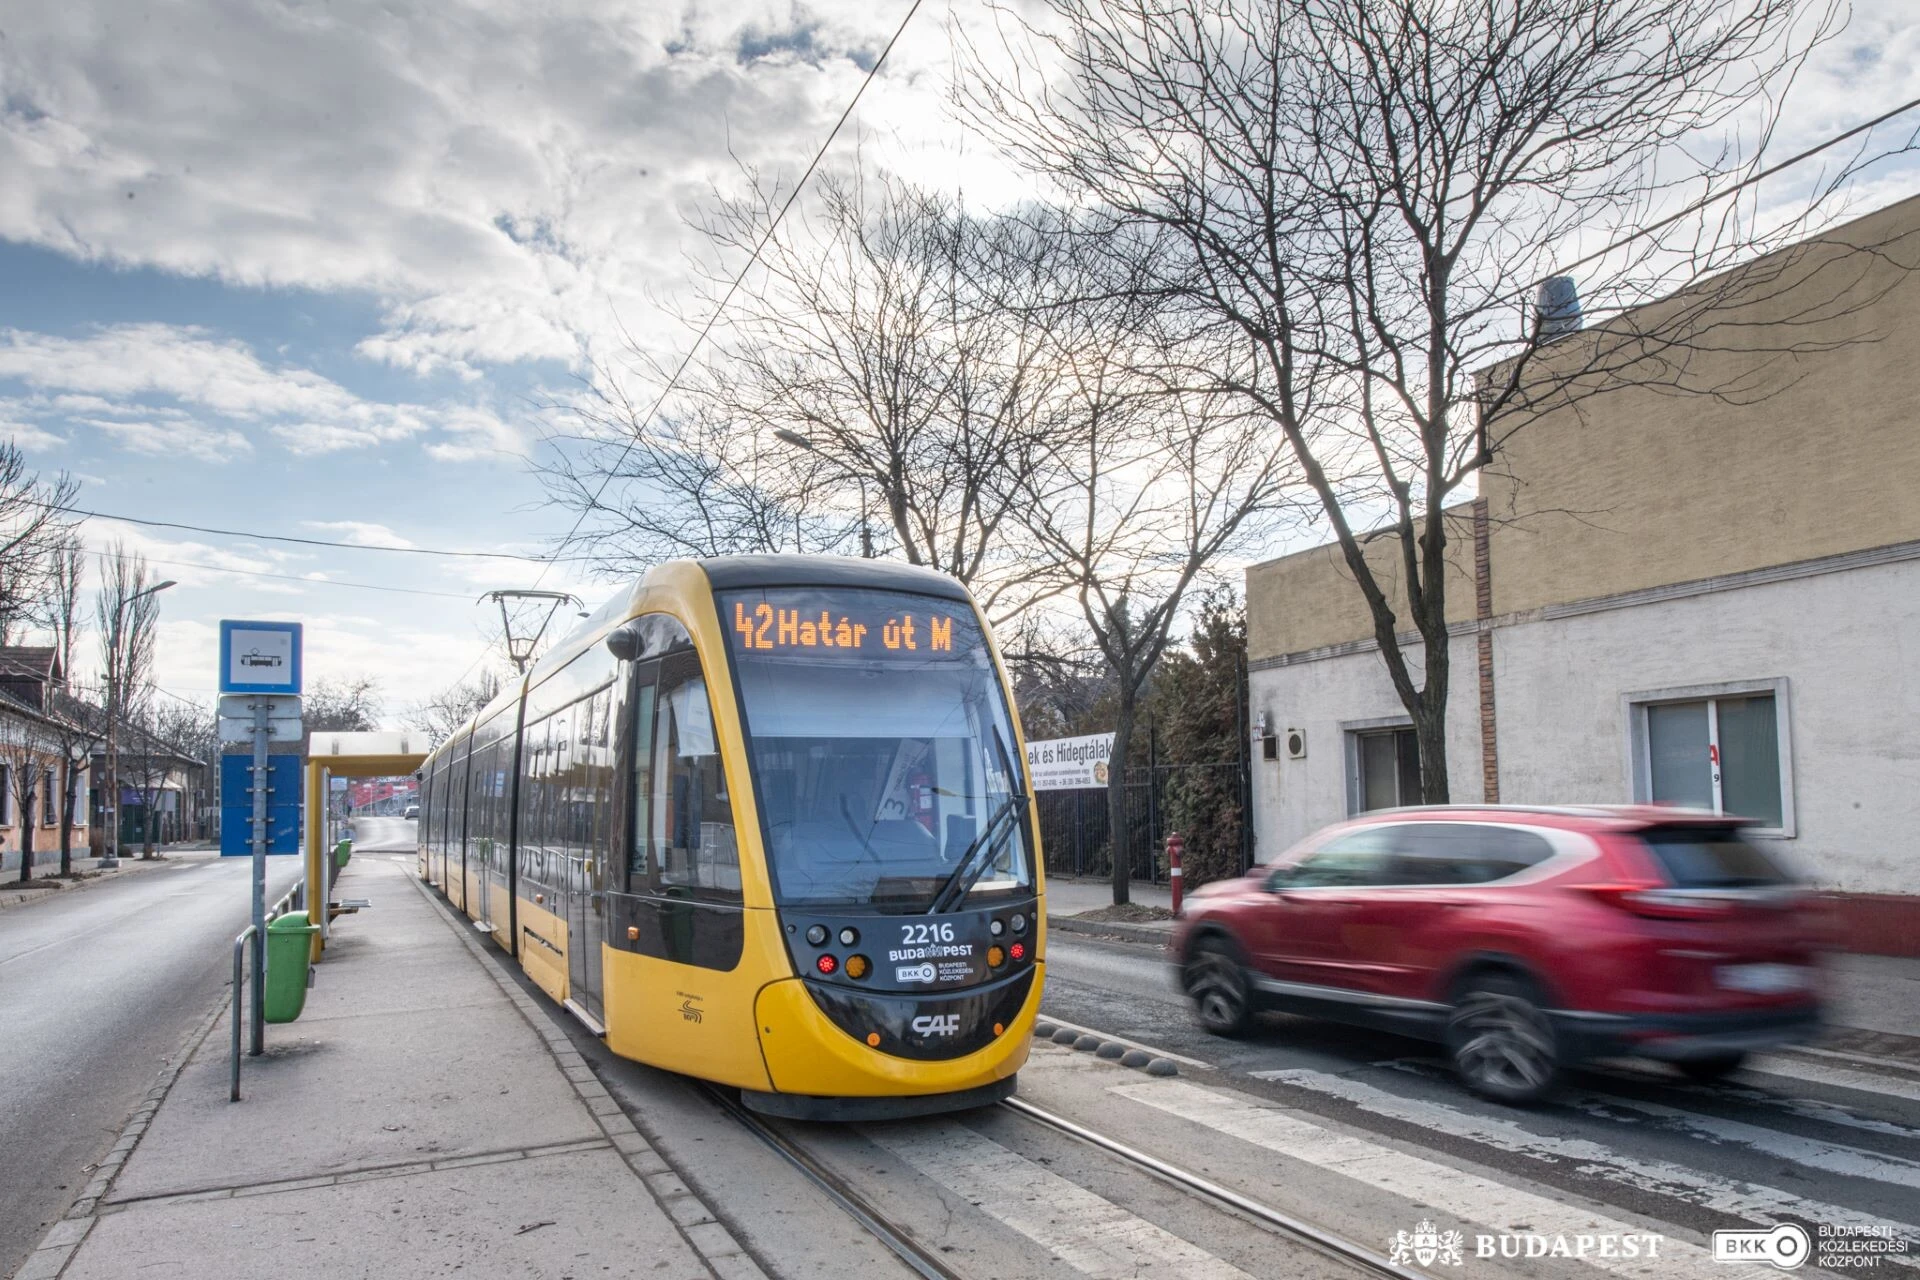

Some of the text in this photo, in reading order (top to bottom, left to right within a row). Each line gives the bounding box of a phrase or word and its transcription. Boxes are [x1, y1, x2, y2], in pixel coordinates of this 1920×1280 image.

[736, 602, 951, 651] 42 Határ út M
[1043, 743, 1054, 763] és
[1057, 738, 1112, 765] Hidegtálak
[901, 922, 955, 944] 2216
[912, 1014, 960, 1037] CAF
